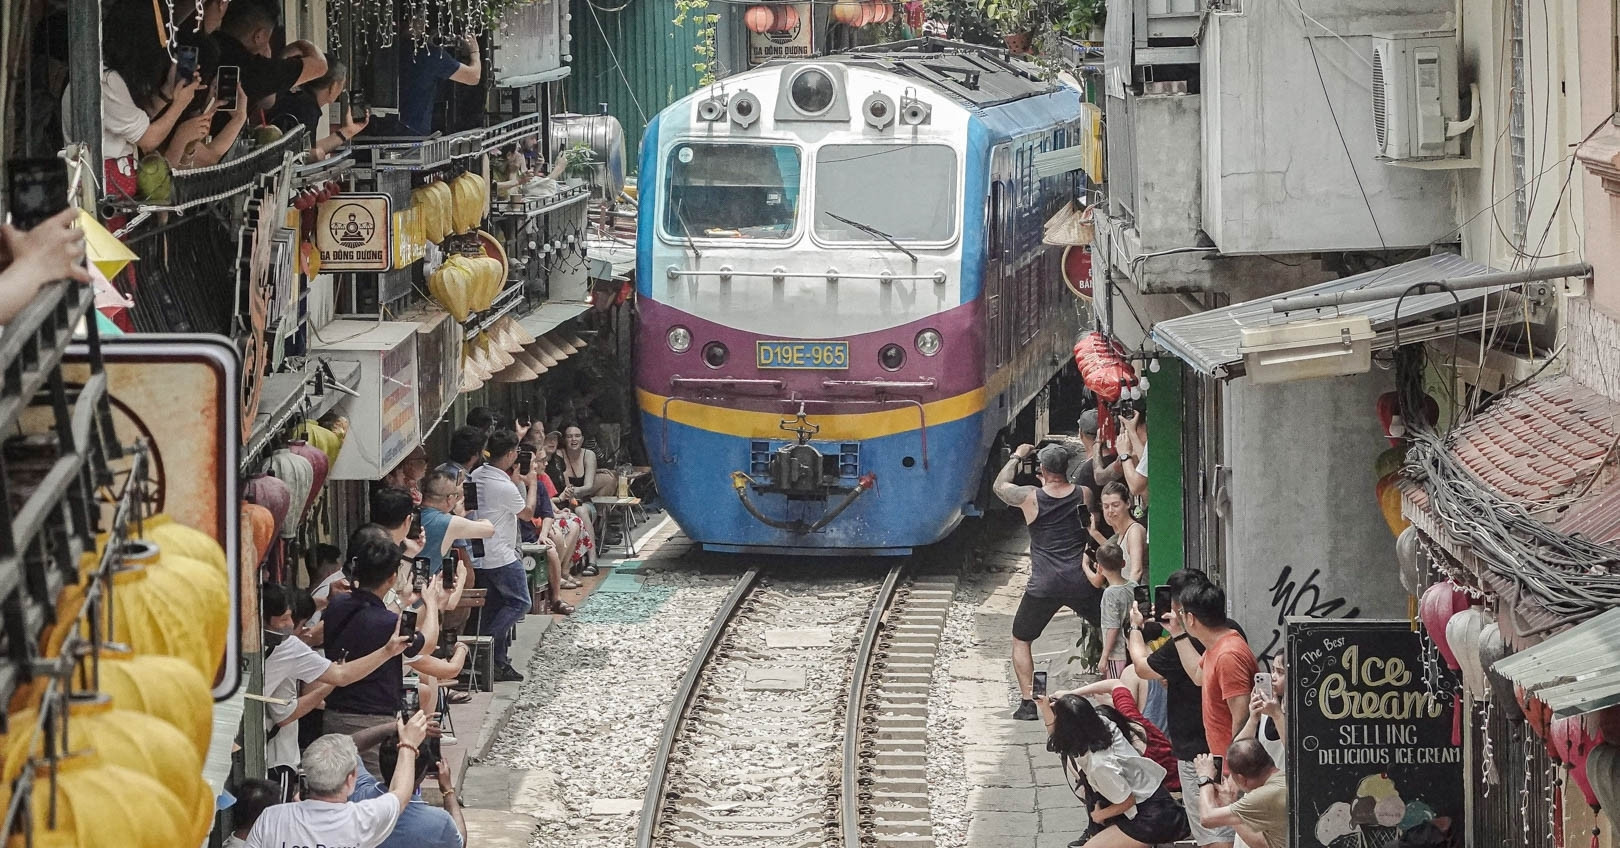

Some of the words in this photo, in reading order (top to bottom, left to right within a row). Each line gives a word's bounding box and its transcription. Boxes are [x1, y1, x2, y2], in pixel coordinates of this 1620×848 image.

[320, 250, 331, 260] GA
[760, 345, 845, 365] D19E-965
[1301, 648, 1323, 665] The
[1323, 637, 1345, 651] Best
[1341, 644, 1412, 687] Ice
[1318, 673, 1443, 719] Cream
[1339, 725, 1418, 746] SELLING
[1318, 748, 1390, 765] DELICIOUS
[1395, 747, 1416, 765] ICE
[1417, 747, 1461, 764] CREAM
